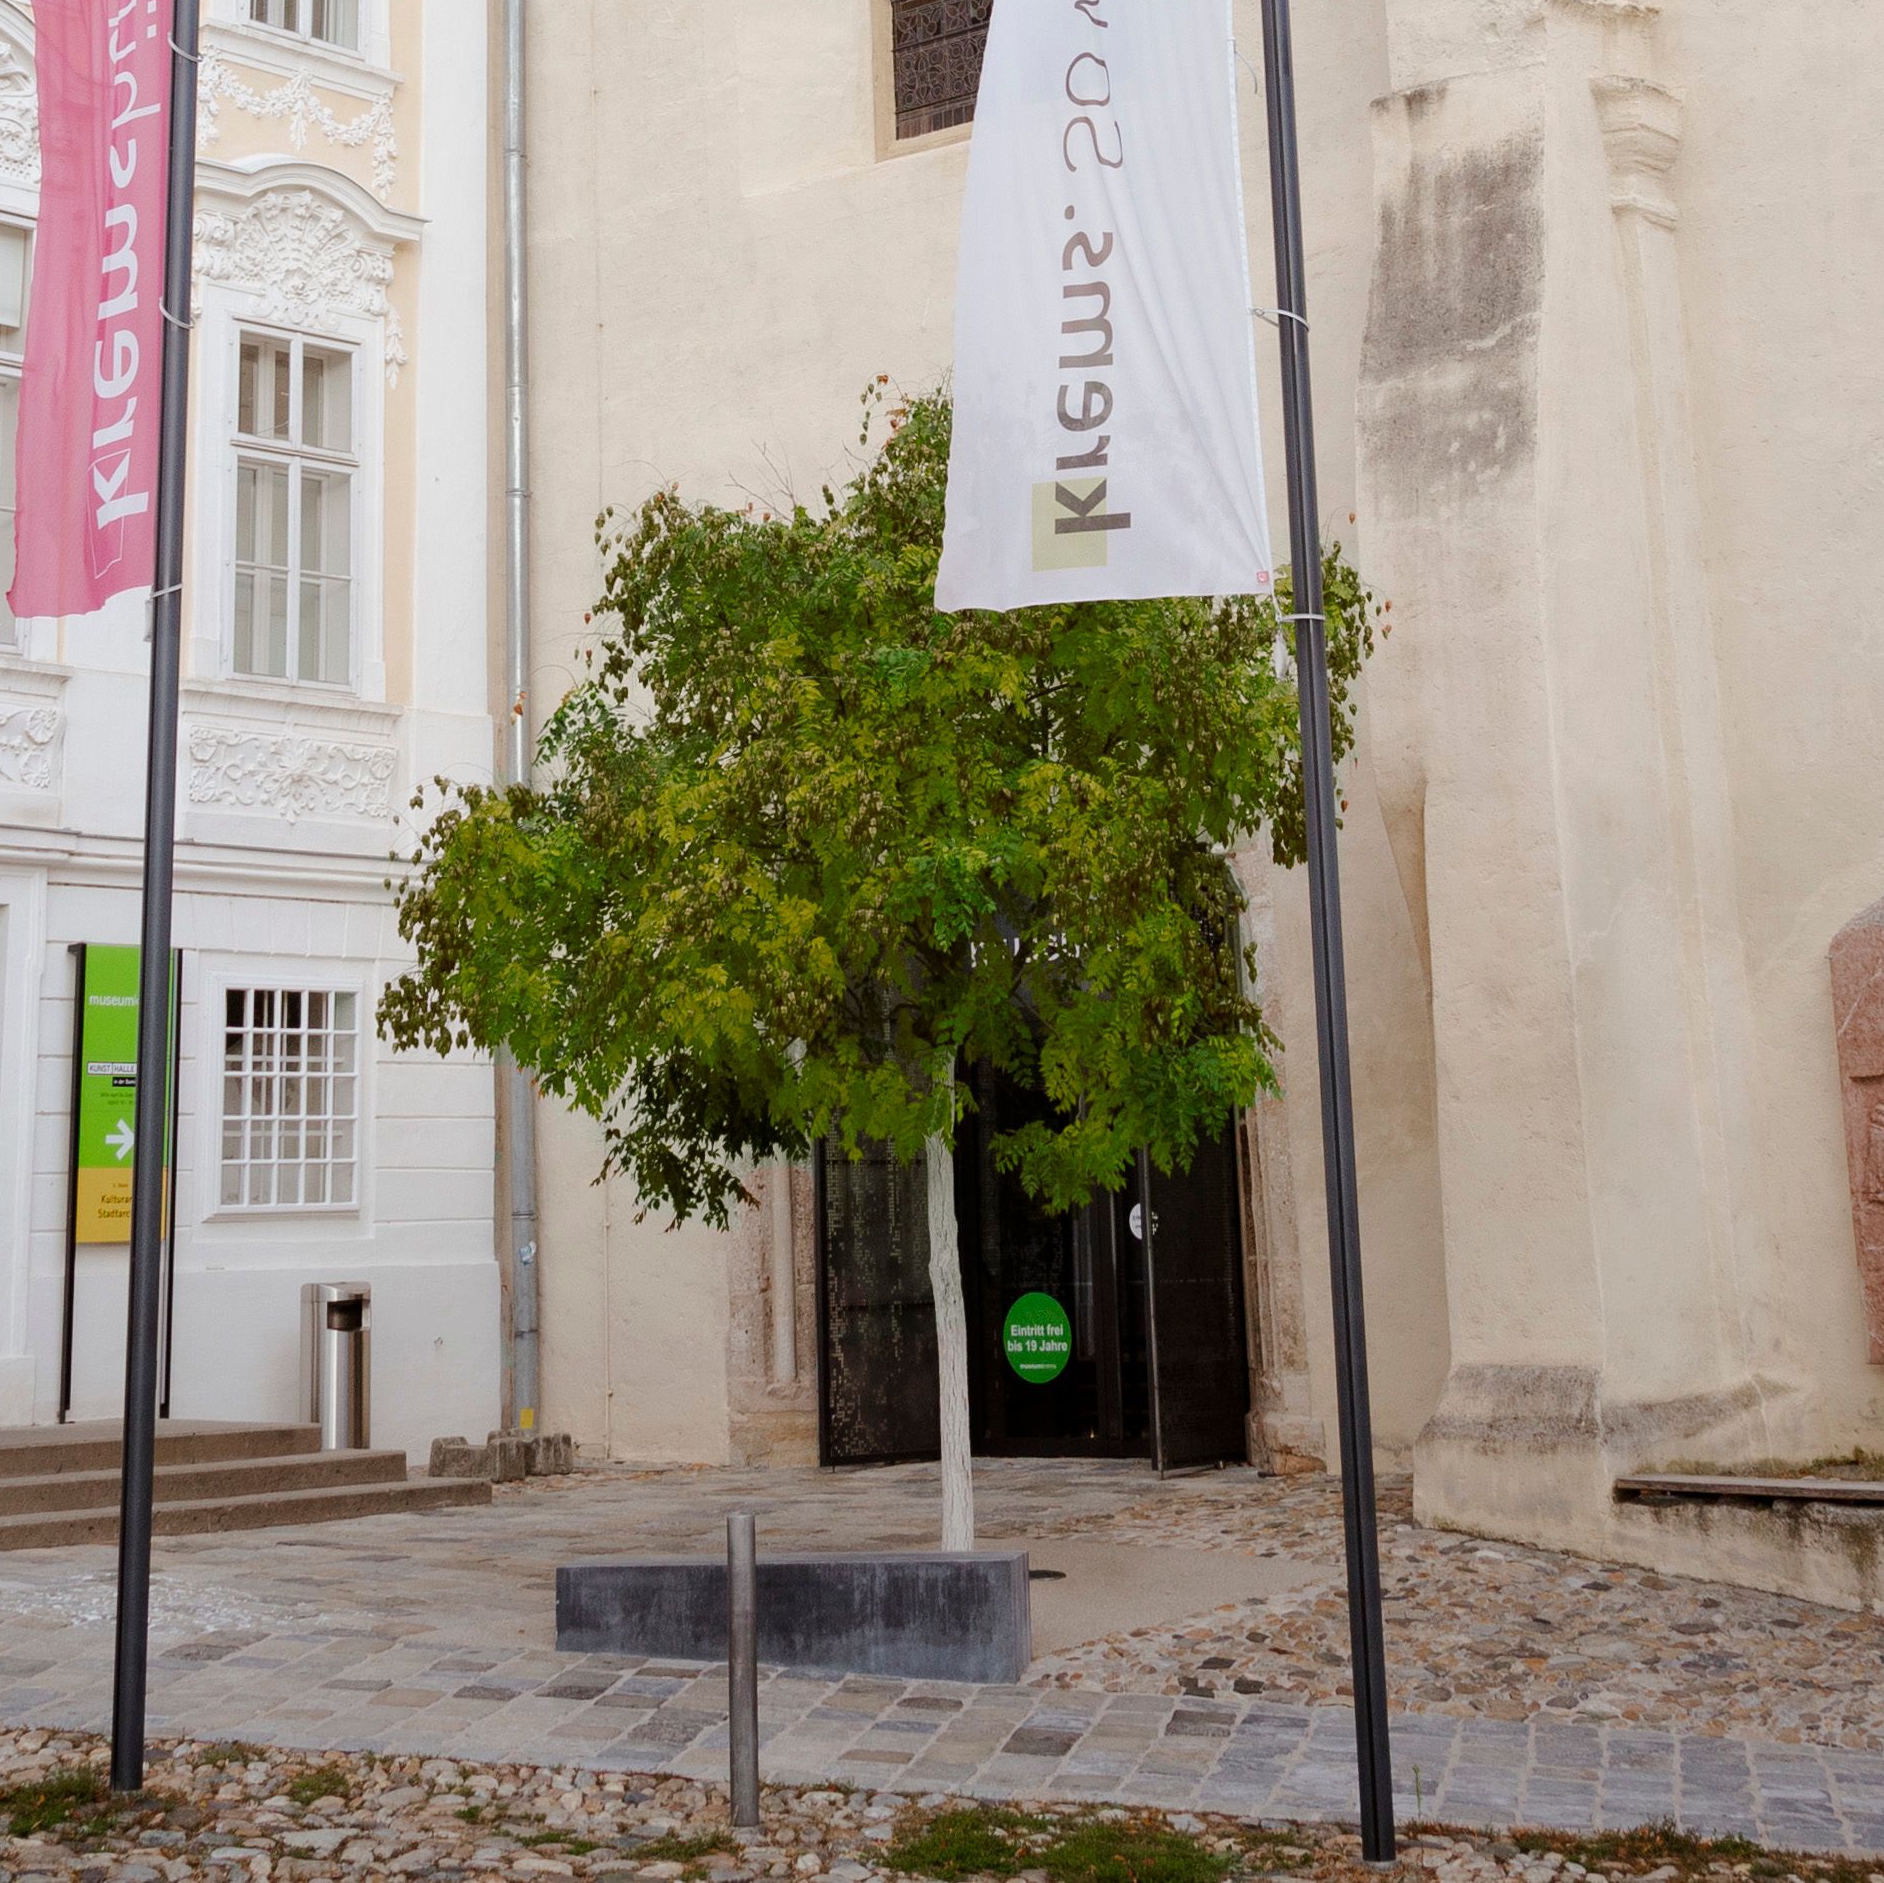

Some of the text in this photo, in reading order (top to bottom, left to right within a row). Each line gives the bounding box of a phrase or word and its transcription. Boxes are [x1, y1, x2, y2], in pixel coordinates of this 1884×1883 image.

[89, 1064, 135, 1073] KUNST HALLE
[1011, 1324, 1064, 1336] Eintritt frei
[1007, 1340, 1068, 1352] bis 19 Jahre
